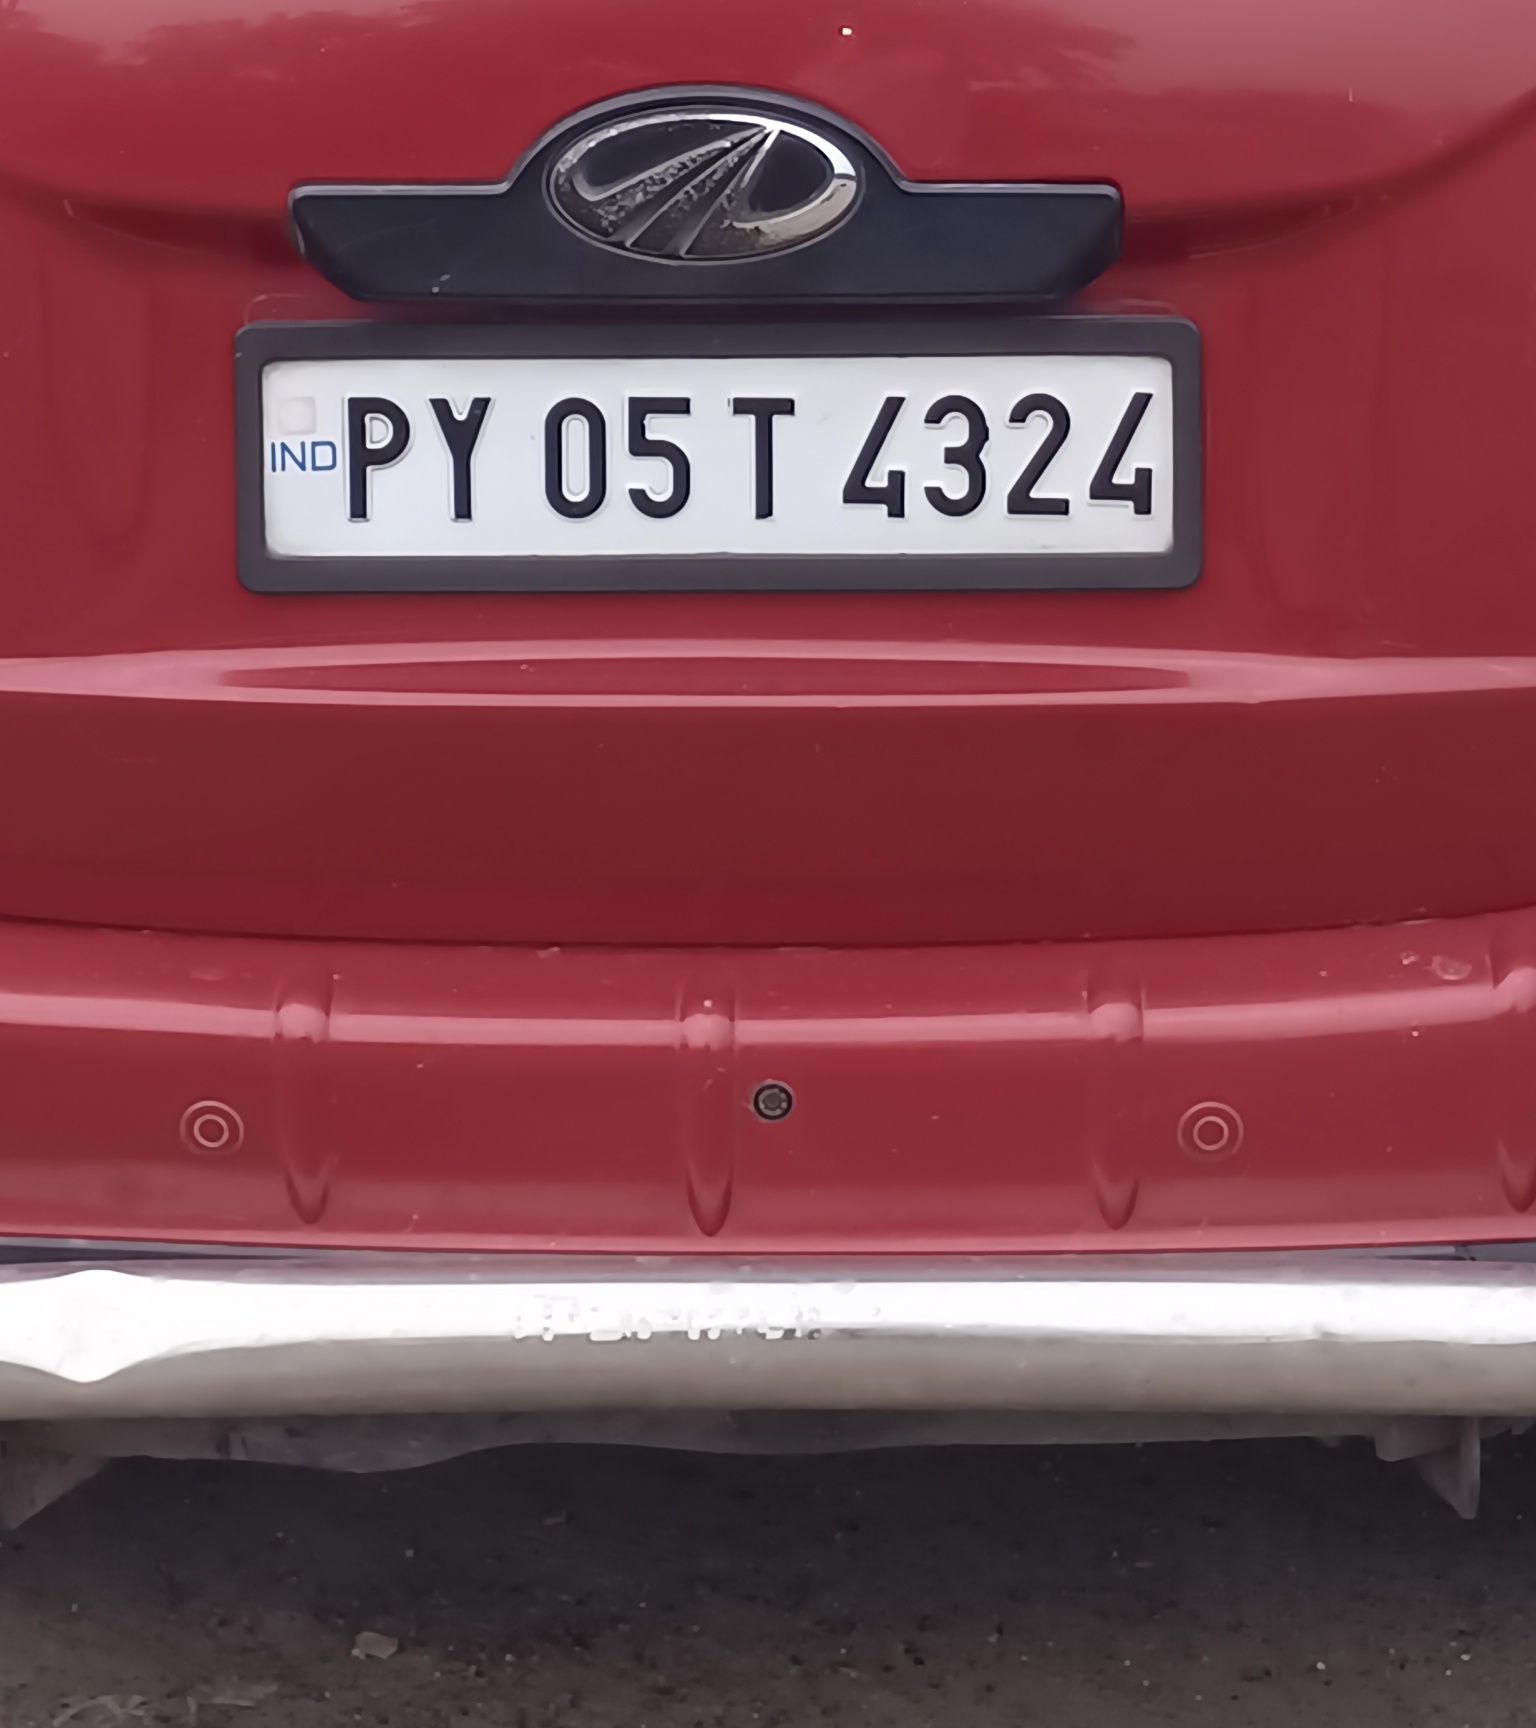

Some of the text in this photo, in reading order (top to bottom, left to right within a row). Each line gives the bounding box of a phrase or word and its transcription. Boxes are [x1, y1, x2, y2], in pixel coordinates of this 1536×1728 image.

[269, 439, 338, 474] IND
[344, 395, 493, 522] PY
[841, 391, 1154, 519] 4324
